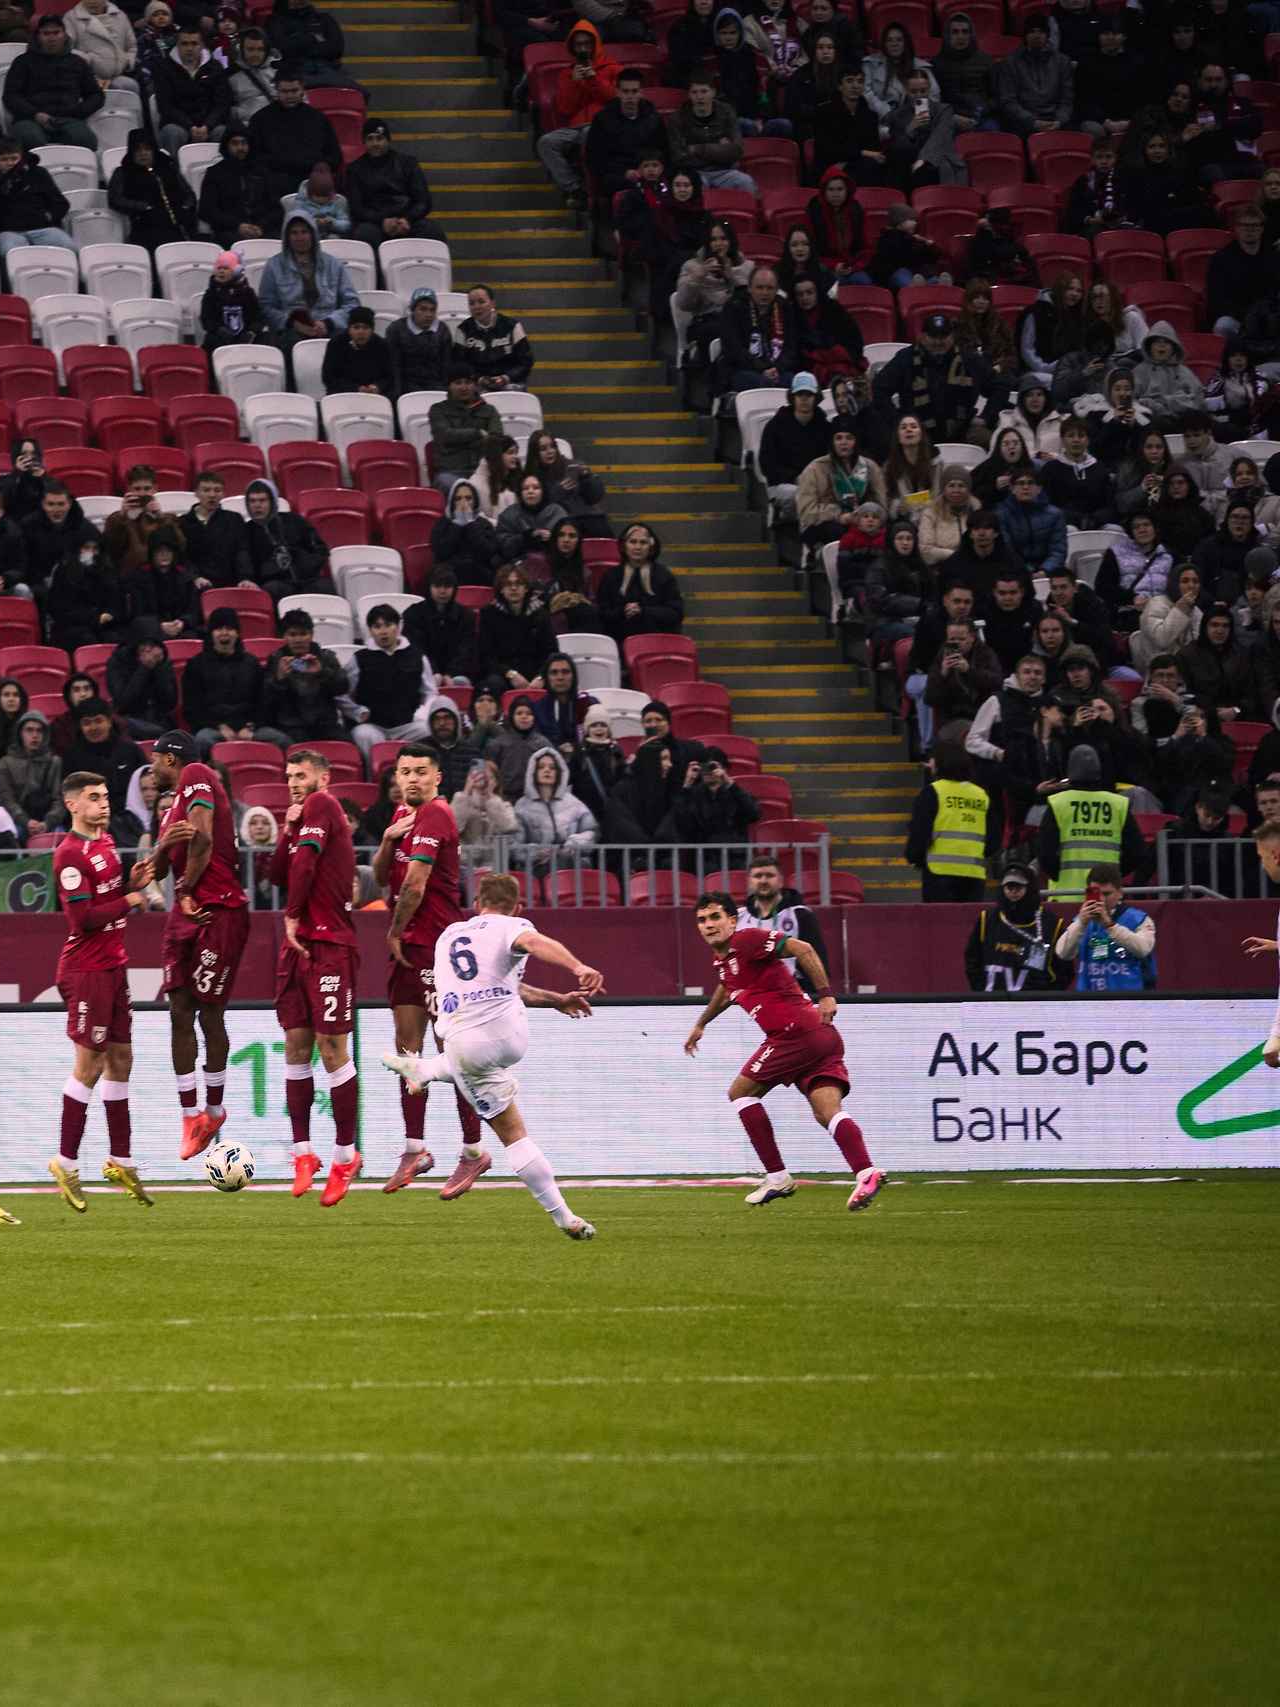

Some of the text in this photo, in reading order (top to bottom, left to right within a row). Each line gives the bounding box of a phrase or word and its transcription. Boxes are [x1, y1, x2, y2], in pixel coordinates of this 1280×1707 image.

[1070, 800, 1113, 825] 7979
[1071, 828, 1113, 838] STEWARD
[6, 868, 50, 913] C
[449, 936, 479, 982] 6
[319, 975, 341, 985] FON
[419, 968, 434, 978] FO
[984, 964, 1029, 993] TV
[320, 984, 341, 993] BET
[323, 995, 339, 1022] 2
[928, 1030, 1149, 1086] Ак Барс
[931, 1097, 1063, 1142] Банк
